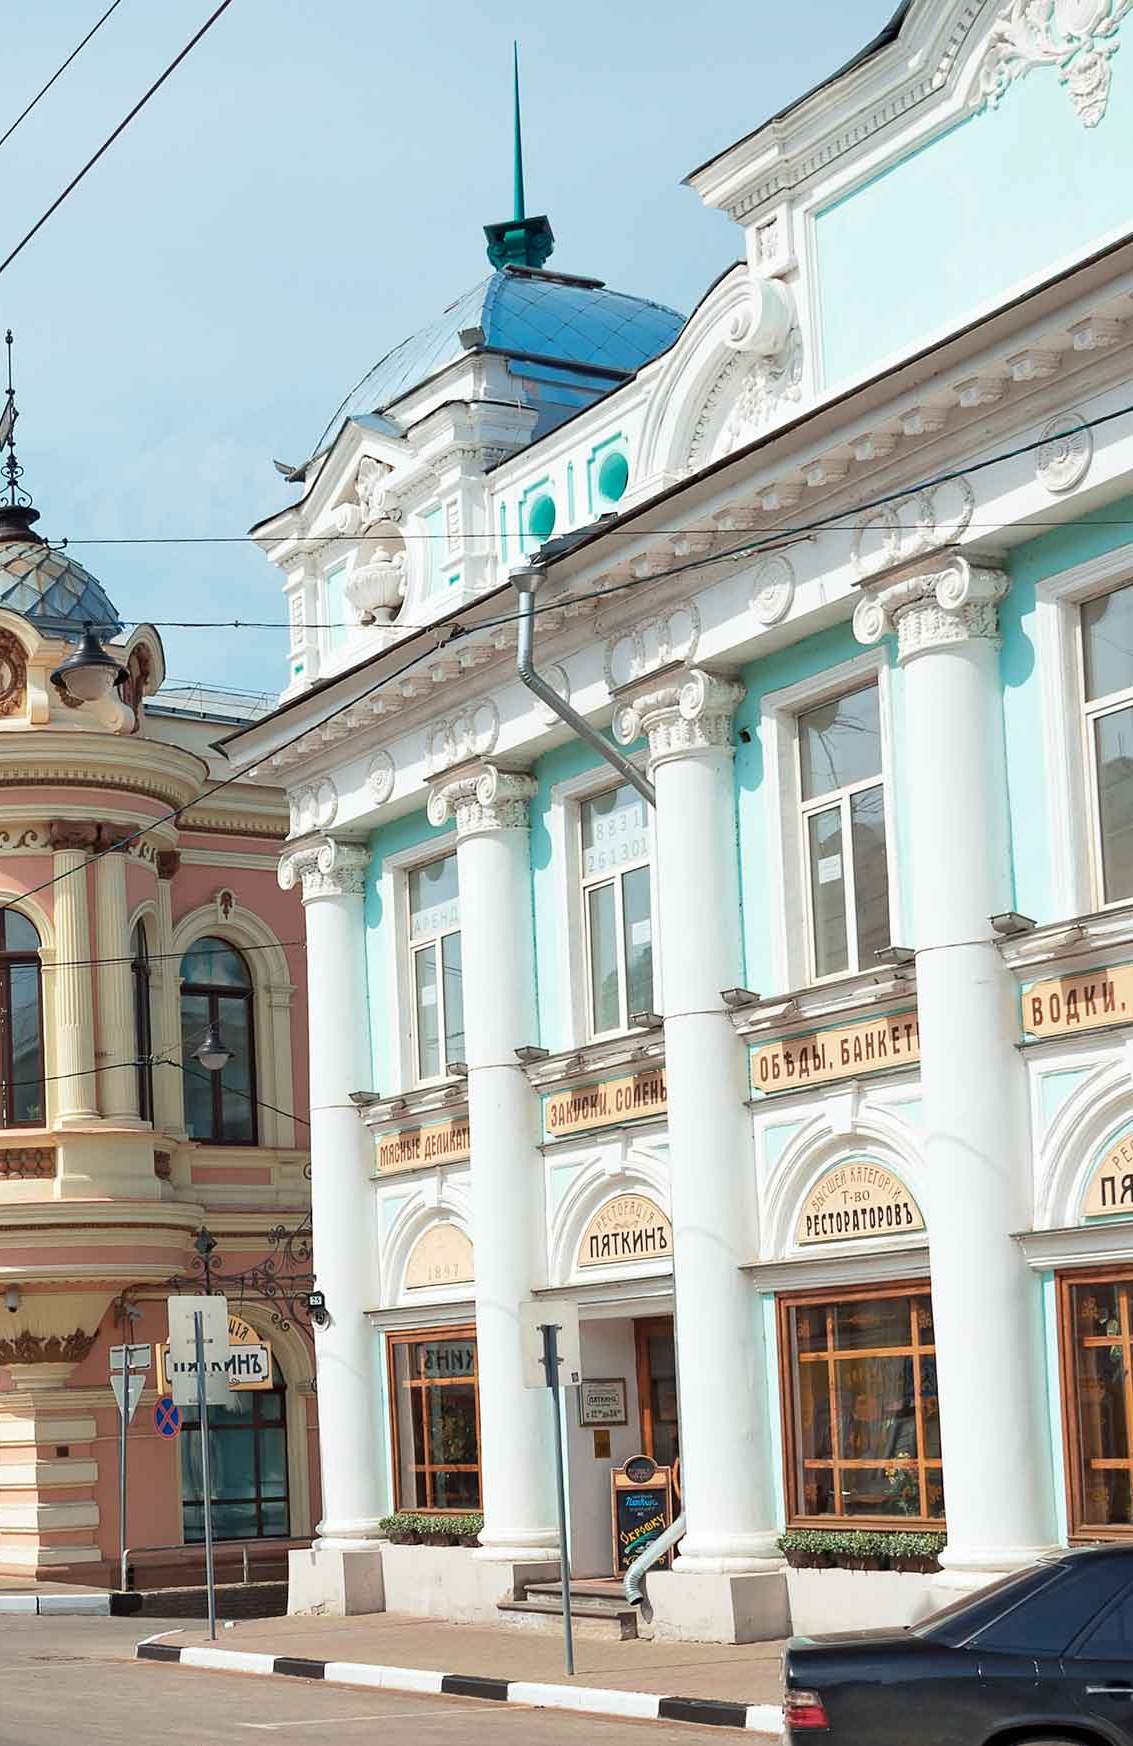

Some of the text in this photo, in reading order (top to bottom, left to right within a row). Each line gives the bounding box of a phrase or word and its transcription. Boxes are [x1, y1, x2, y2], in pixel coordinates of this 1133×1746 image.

[380, 1137, 420, 1167] МЯСНЫЕ
[806, 1202, 913, 1236] РЕСТОРАТОРОВЪ
[590, 1226, 667, 1258] ПЯТКИНЪ
